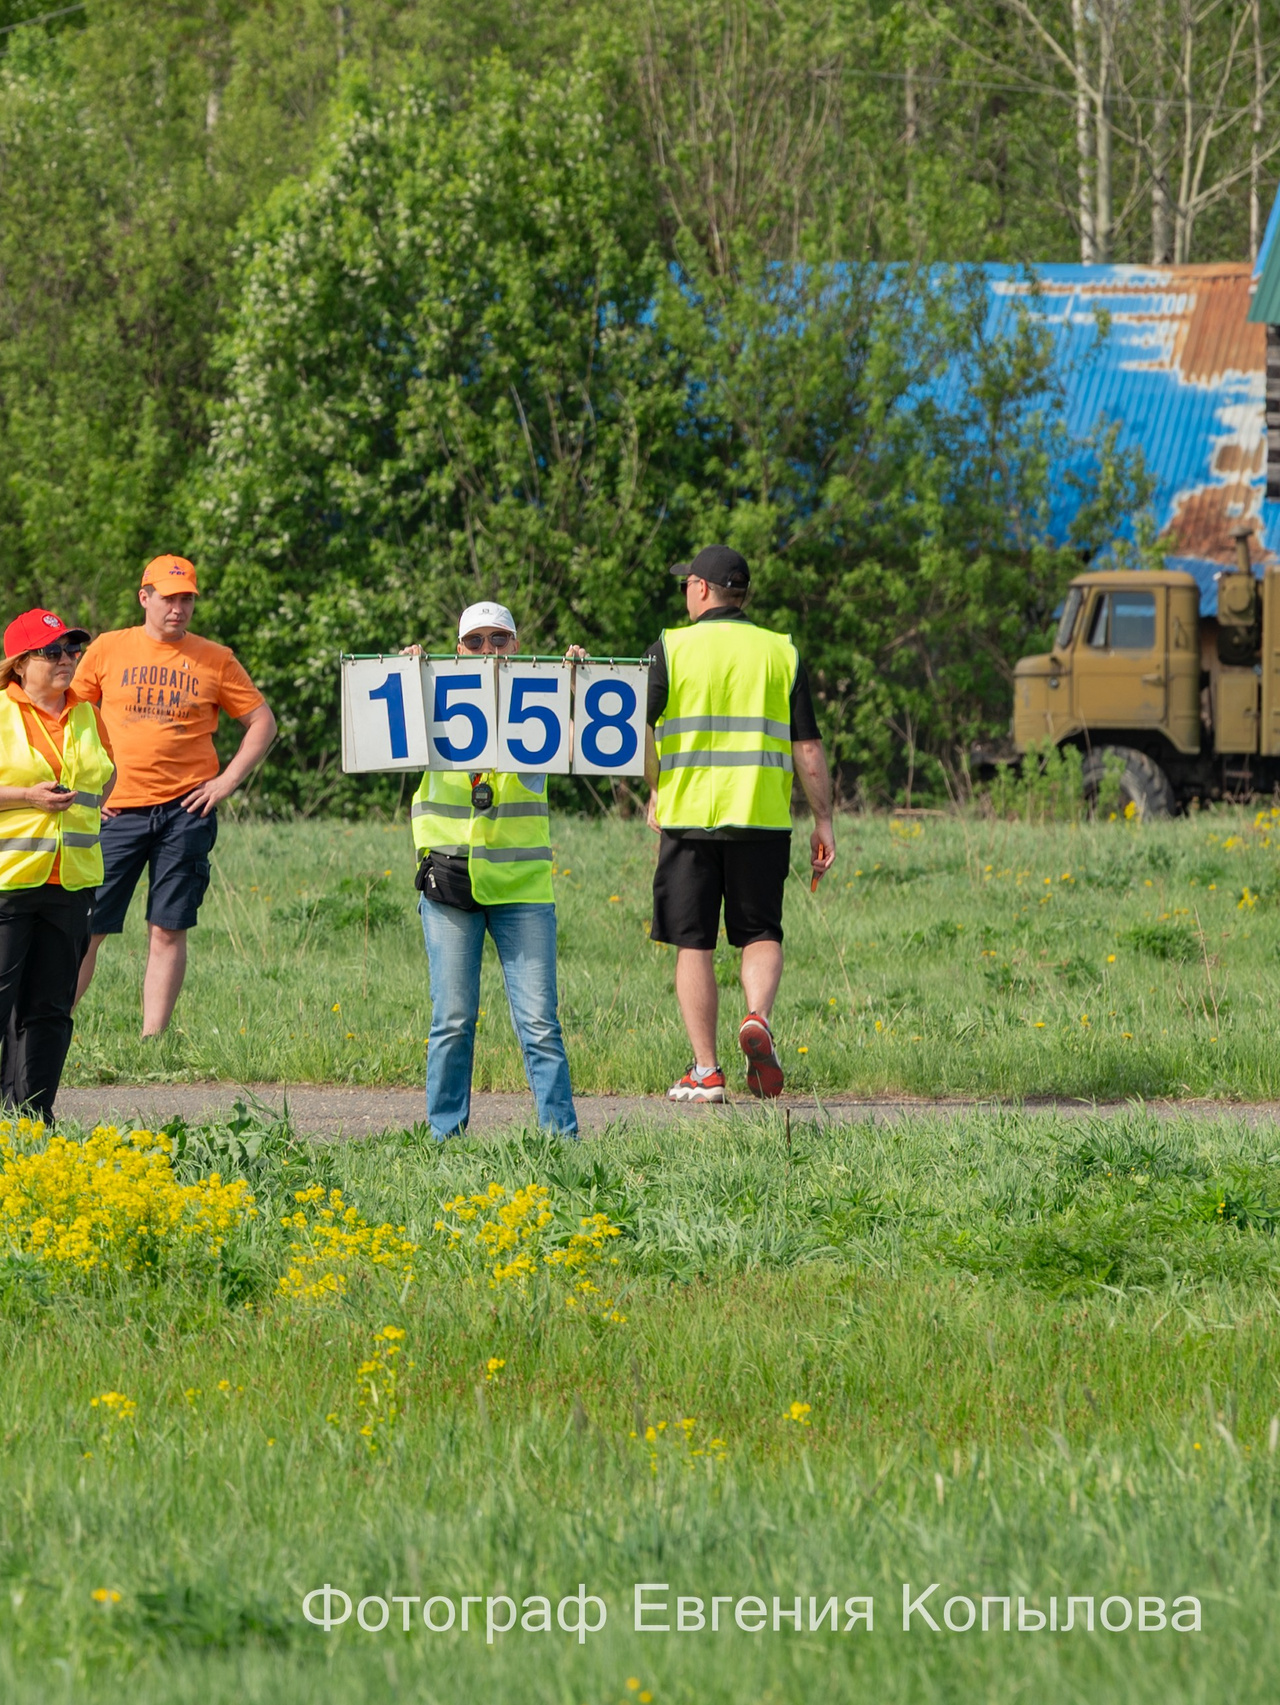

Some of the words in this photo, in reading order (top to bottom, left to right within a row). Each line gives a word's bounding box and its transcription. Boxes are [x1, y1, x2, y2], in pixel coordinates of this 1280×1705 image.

[121, 665, 199, 697] AEROBATIC
[136, 686, 180, 708] TEAM
[369, 672, 638, 768] 1558
